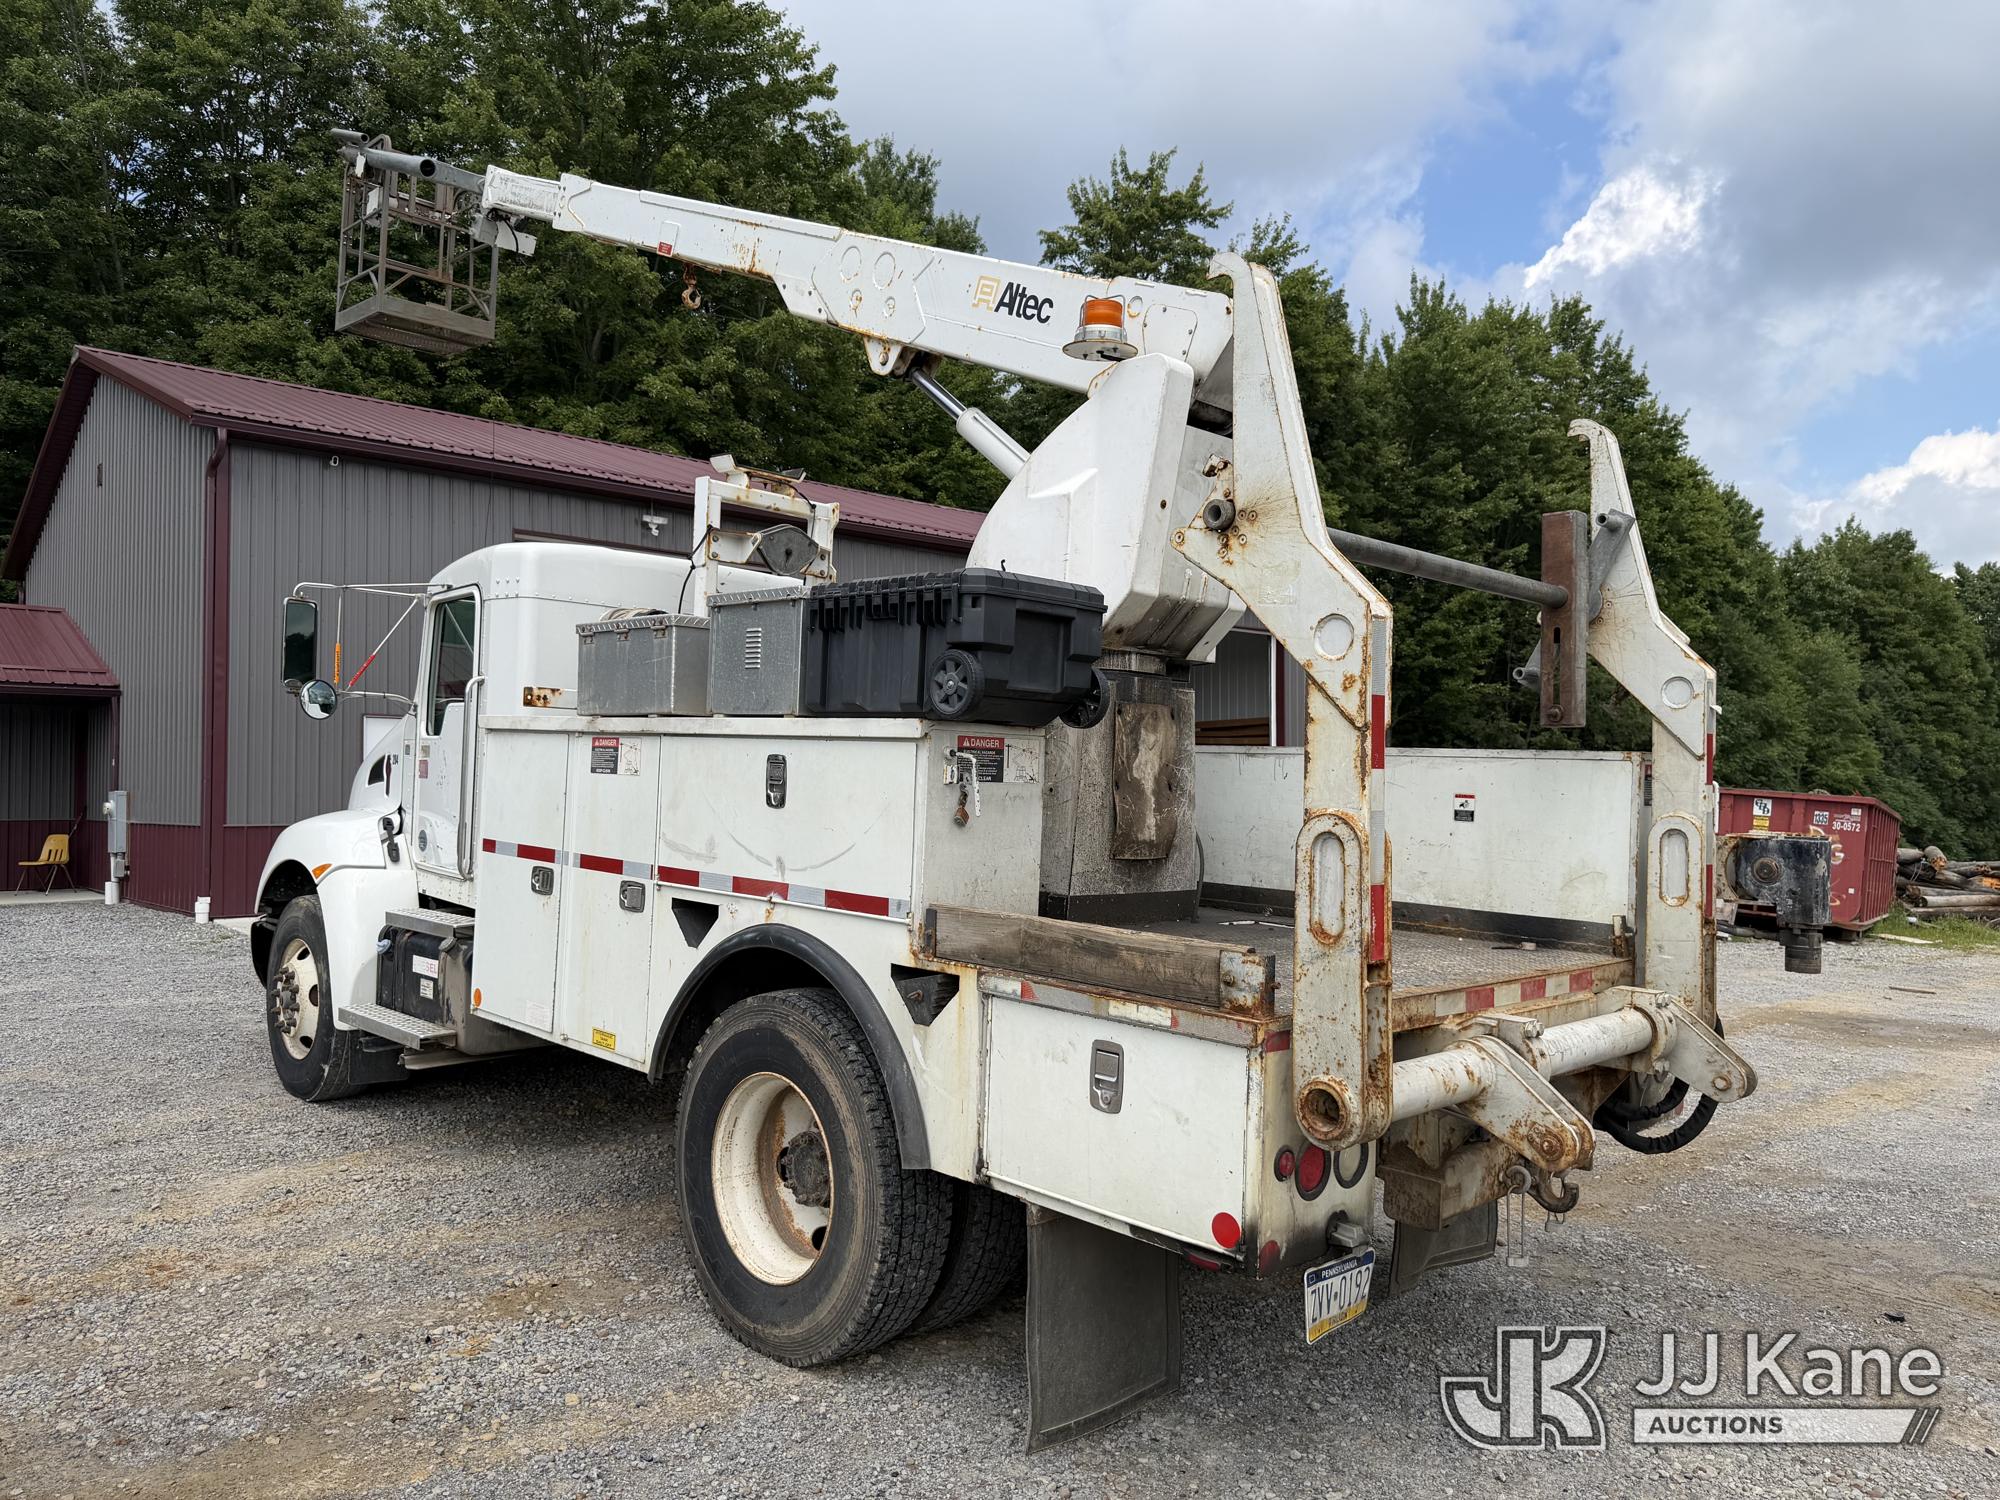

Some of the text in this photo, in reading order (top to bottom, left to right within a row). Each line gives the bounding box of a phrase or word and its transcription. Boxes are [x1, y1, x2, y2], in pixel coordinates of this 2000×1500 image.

[994, 281, 1054, 324] Altec
[970, 738, 1000, 748] DANGER
[1814, 812, 1828, 825] 1335
[1832, 821, 1861, 832] 30-0572
[1321, 1259, 1358, 1279] PENNSYLVANIA
